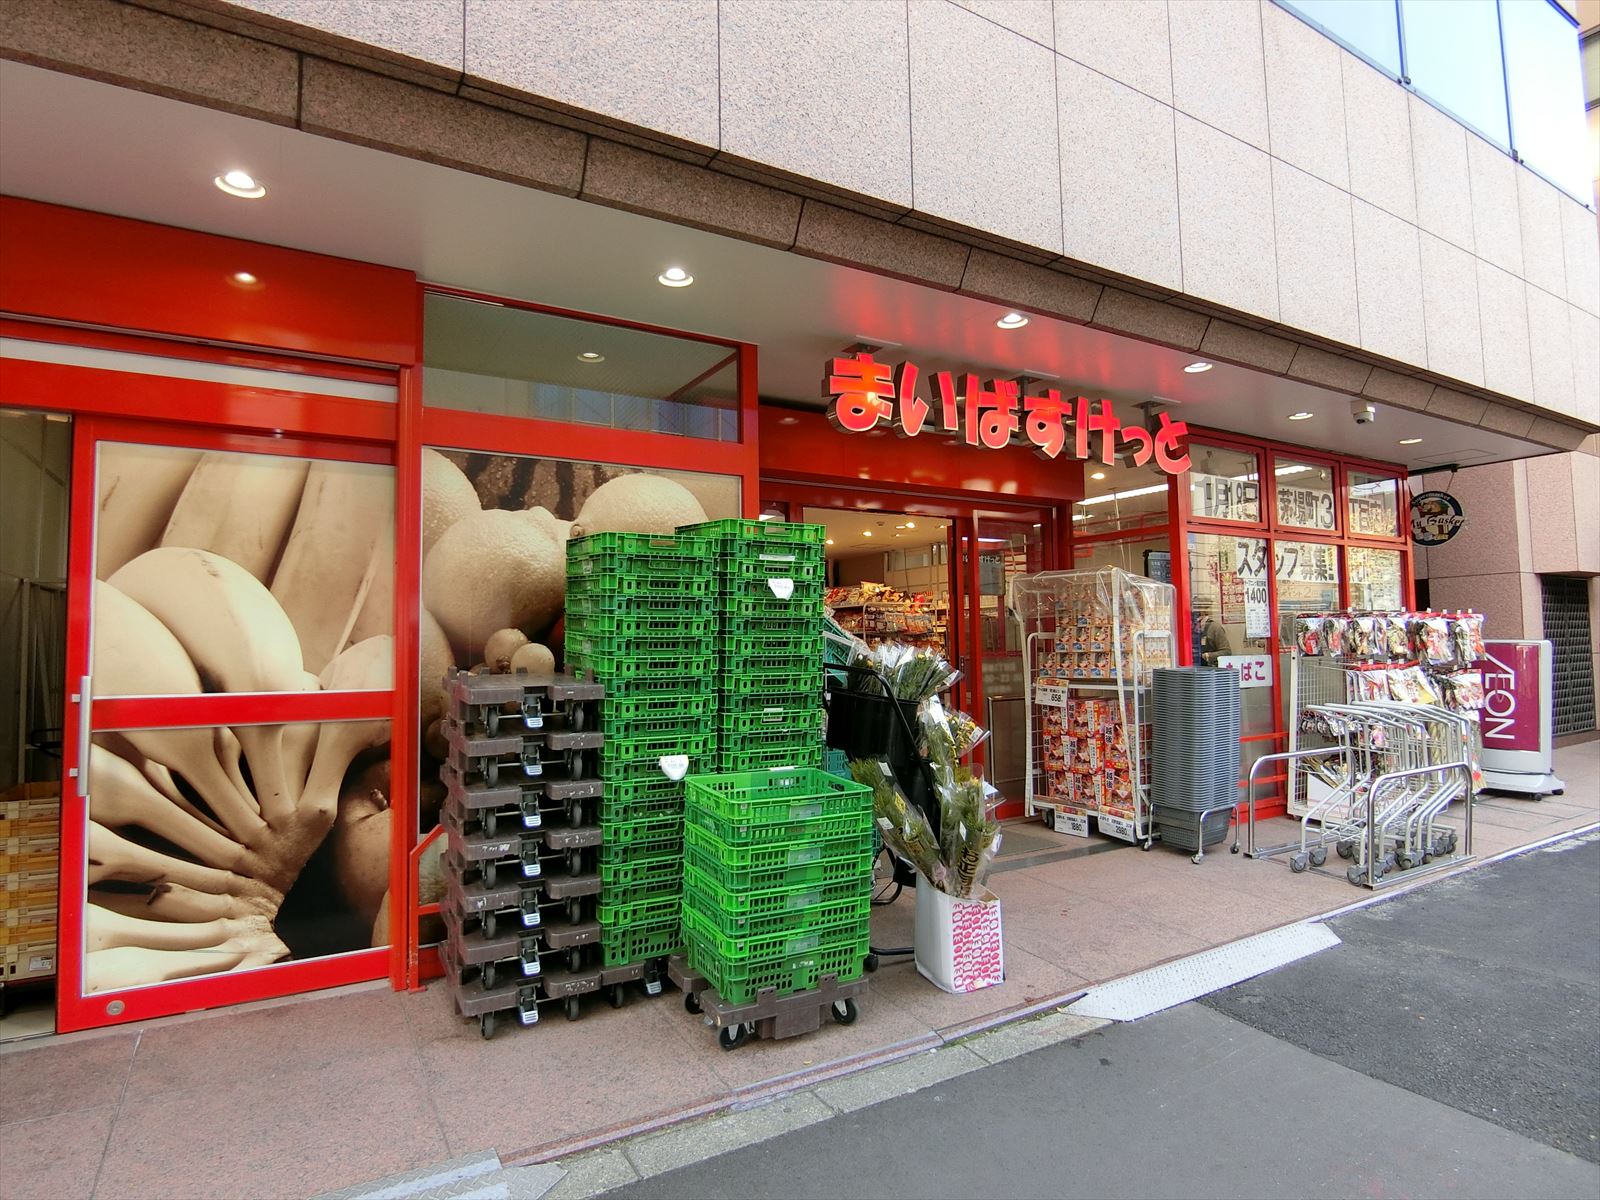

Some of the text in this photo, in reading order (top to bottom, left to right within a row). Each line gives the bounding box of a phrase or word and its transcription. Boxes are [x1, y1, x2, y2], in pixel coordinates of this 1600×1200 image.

[828, 353, 1193, 475] まいばすけっと
[1246, 587, 1267, 604] 1400
